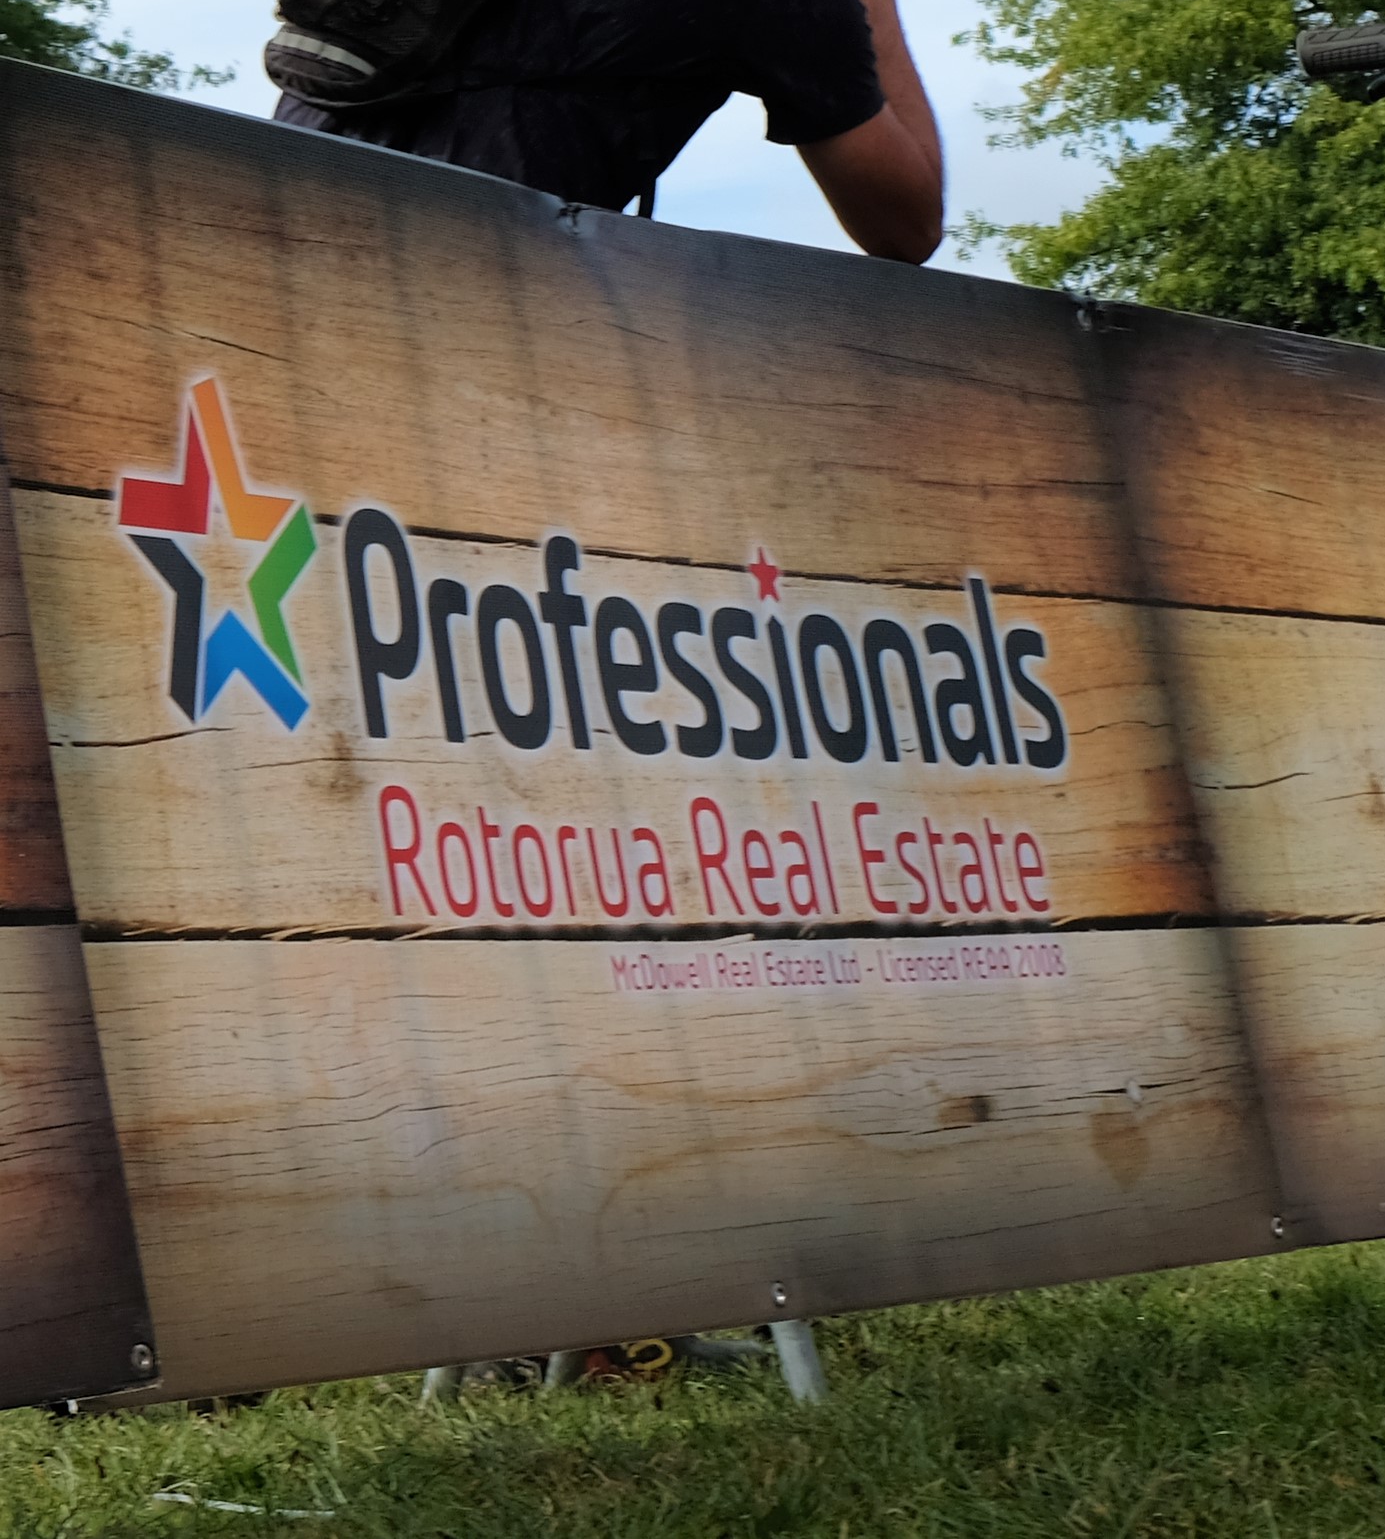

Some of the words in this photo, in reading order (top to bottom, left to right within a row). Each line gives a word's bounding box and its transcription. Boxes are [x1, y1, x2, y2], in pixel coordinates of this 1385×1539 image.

[344, 508, 1067, 768] Professionals
[379, 785, 674, 917] Rotorua
[690, 797, 838, 915] Real
[853, 802, 1049, 914] Estate
[611, 953, 712, 990] McDowell
[715, 952, 755, 988] Real
[764, 950, 826, 986] Estate
[827, 950, 861, 984] Ltd
[878, 948, 959, 983] Licensed
[960, 946, 1011, 980] REAA
[1013, 944, 1067, 978] 2008
